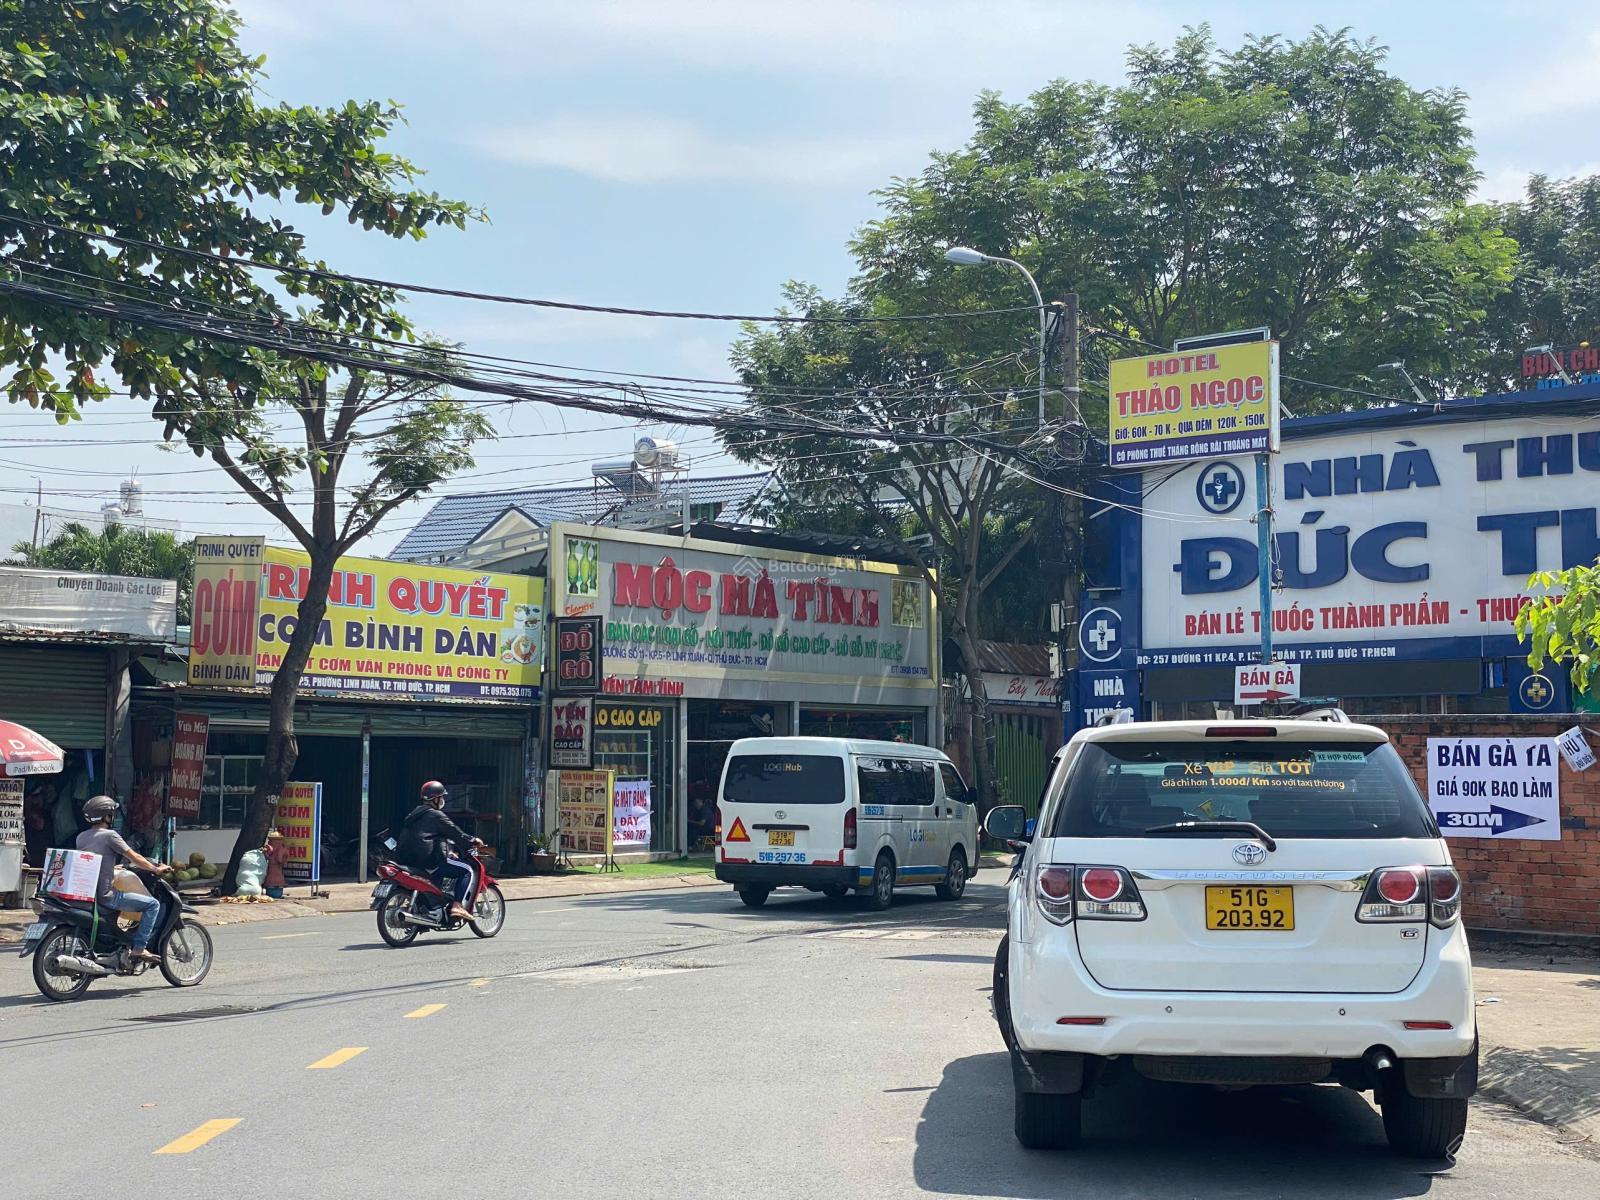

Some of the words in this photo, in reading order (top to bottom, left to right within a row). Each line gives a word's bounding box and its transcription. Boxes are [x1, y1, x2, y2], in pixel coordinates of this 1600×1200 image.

[1148, 353, 1220, 378] HOTEL
[1116, 382, 1184, 419] THẢO
[1190, 376, 1266, 410] NGỌC
[1132, 426, 1147, 438] 60K
[1155, 424, 1163, 435] 70
[1178, 421, 1194, 433] QUA
[1217, 416, 1237, 430] 120K
[1245, 413, 1265, 428] 150K
[1284, 440, 1441, 500] NHÀ
[197, 543, 225, 560] TRỊNH
[227, 539, 261, 559] QUYẾT
[1173, 510, 1430, 595] ĐỨC
[387, 576, 508, 620] QUYẾT
[613, 556, 713, 620] MỘC
[192, 568, 257, 656] CƠM
[1185, 612, 1221, 636] BÁN
[1225, 606, 1244, 634] LẺ
[1319, 602, 1385, 630] THÀNH
[1390, 592, 1449, 625] PHẨM
[344, 616, 423, 653] BÌNH
[434, 625, 497, 657] DÂN
[1153, 655, 1169, 664] 257
[1172, 652, 1201, 664] ĐƯỜNG
[1203, 653, 1212, 662] 11
[1299, 650, 1313, 659] TP.
[1316, 646, 1334, 659] THỦ
[192, 661, 221, 679] BÌNH
[225, 663, 250, 680] DÂN
[319, 657, 351, 672] CƠM
[356, 659, 383, 674] VĂN
[387, 662, 432, 676] PHÒNG
[436, 664, 452, 677] VÀ
[494, 668, 509, 680] TY
[1240, 667, 1270, 686] BÁN
[1275, 667, 1294, 685] GÀ
[435, 684, 451, 694] HCM
[1094, 676, 1125, 697] NHÀ
[611, 709, 635, 726] CAO
[1437, 740, 1481, 767] BÁN
[1488, 739, 1517, 767] GÀ
[1252, 778, 1269, 786] Km
[1437, 776, 1458, 796] GIÁ
[1462, 781, 1487, 796] 90K
[1491, 781, 1518, 797] BAO
[1523, 777, 1552, 798] LÀM
[1447, 813, 1502, 826] 30M
[1230, 889, 1268, 906] 51G
[1216, 910, 1284, 927] 203.92
